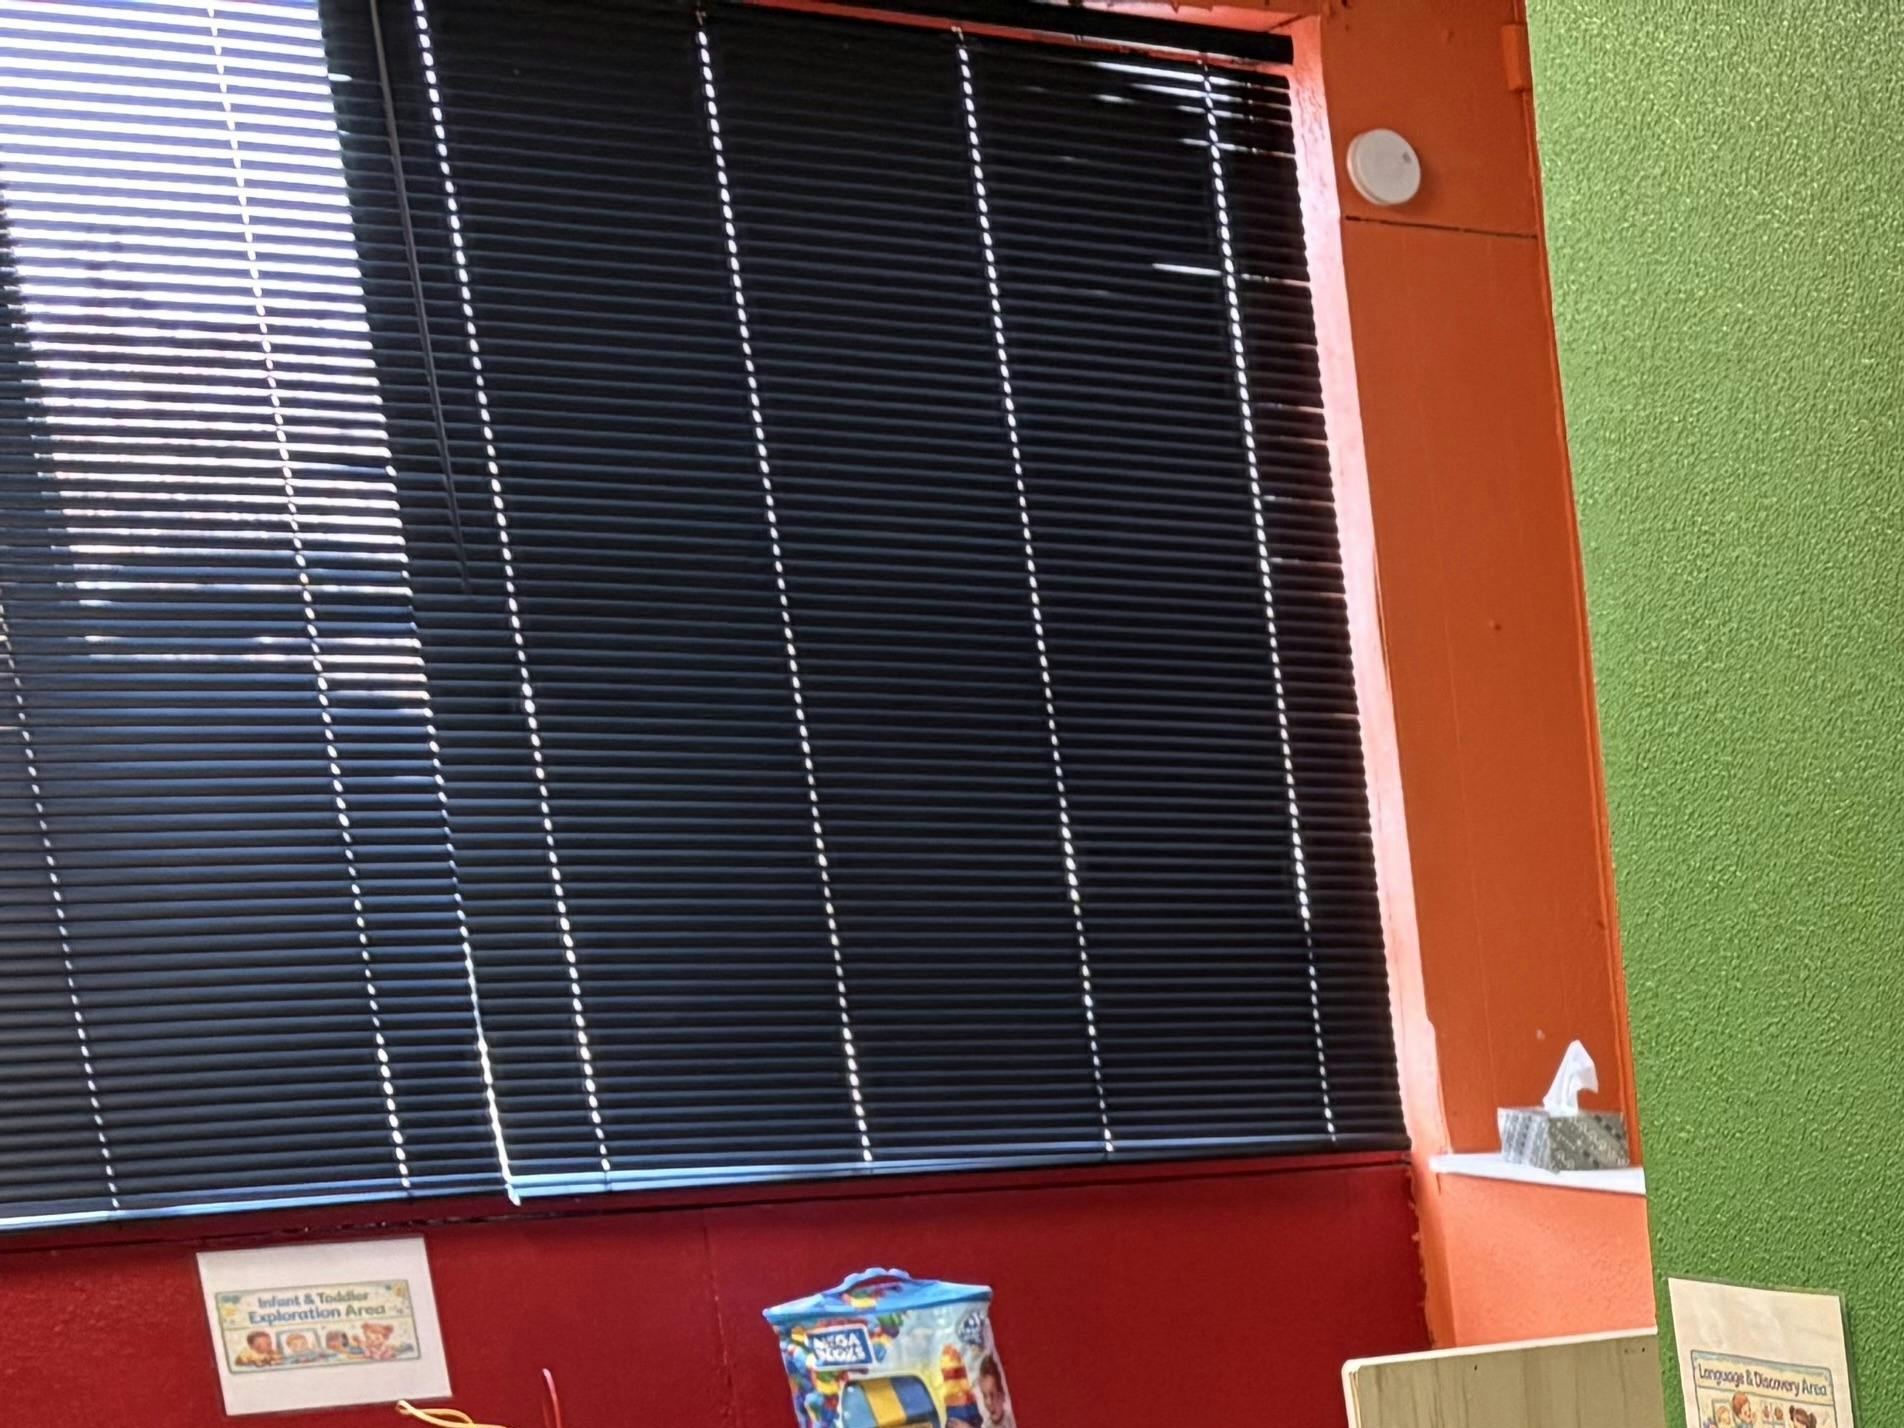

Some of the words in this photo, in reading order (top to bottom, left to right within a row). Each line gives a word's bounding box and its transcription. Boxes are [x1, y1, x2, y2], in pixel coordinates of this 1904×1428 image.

[258, 1294, 301, 1309] Infant
[303, 1293, 315, 1307] &
[317, 1289, 370, 1305] Toddler
[248, 1305, 341, 1327] Exploration
[345, 1302, 387, 1317] Area
[1698, 1362, 1745, 1388] Language
[1745, 1368, 1754, 1387] &
[1754, 1370, 1800, 1397] Discovery
[1801, 1377, 1828, 1397] Area
